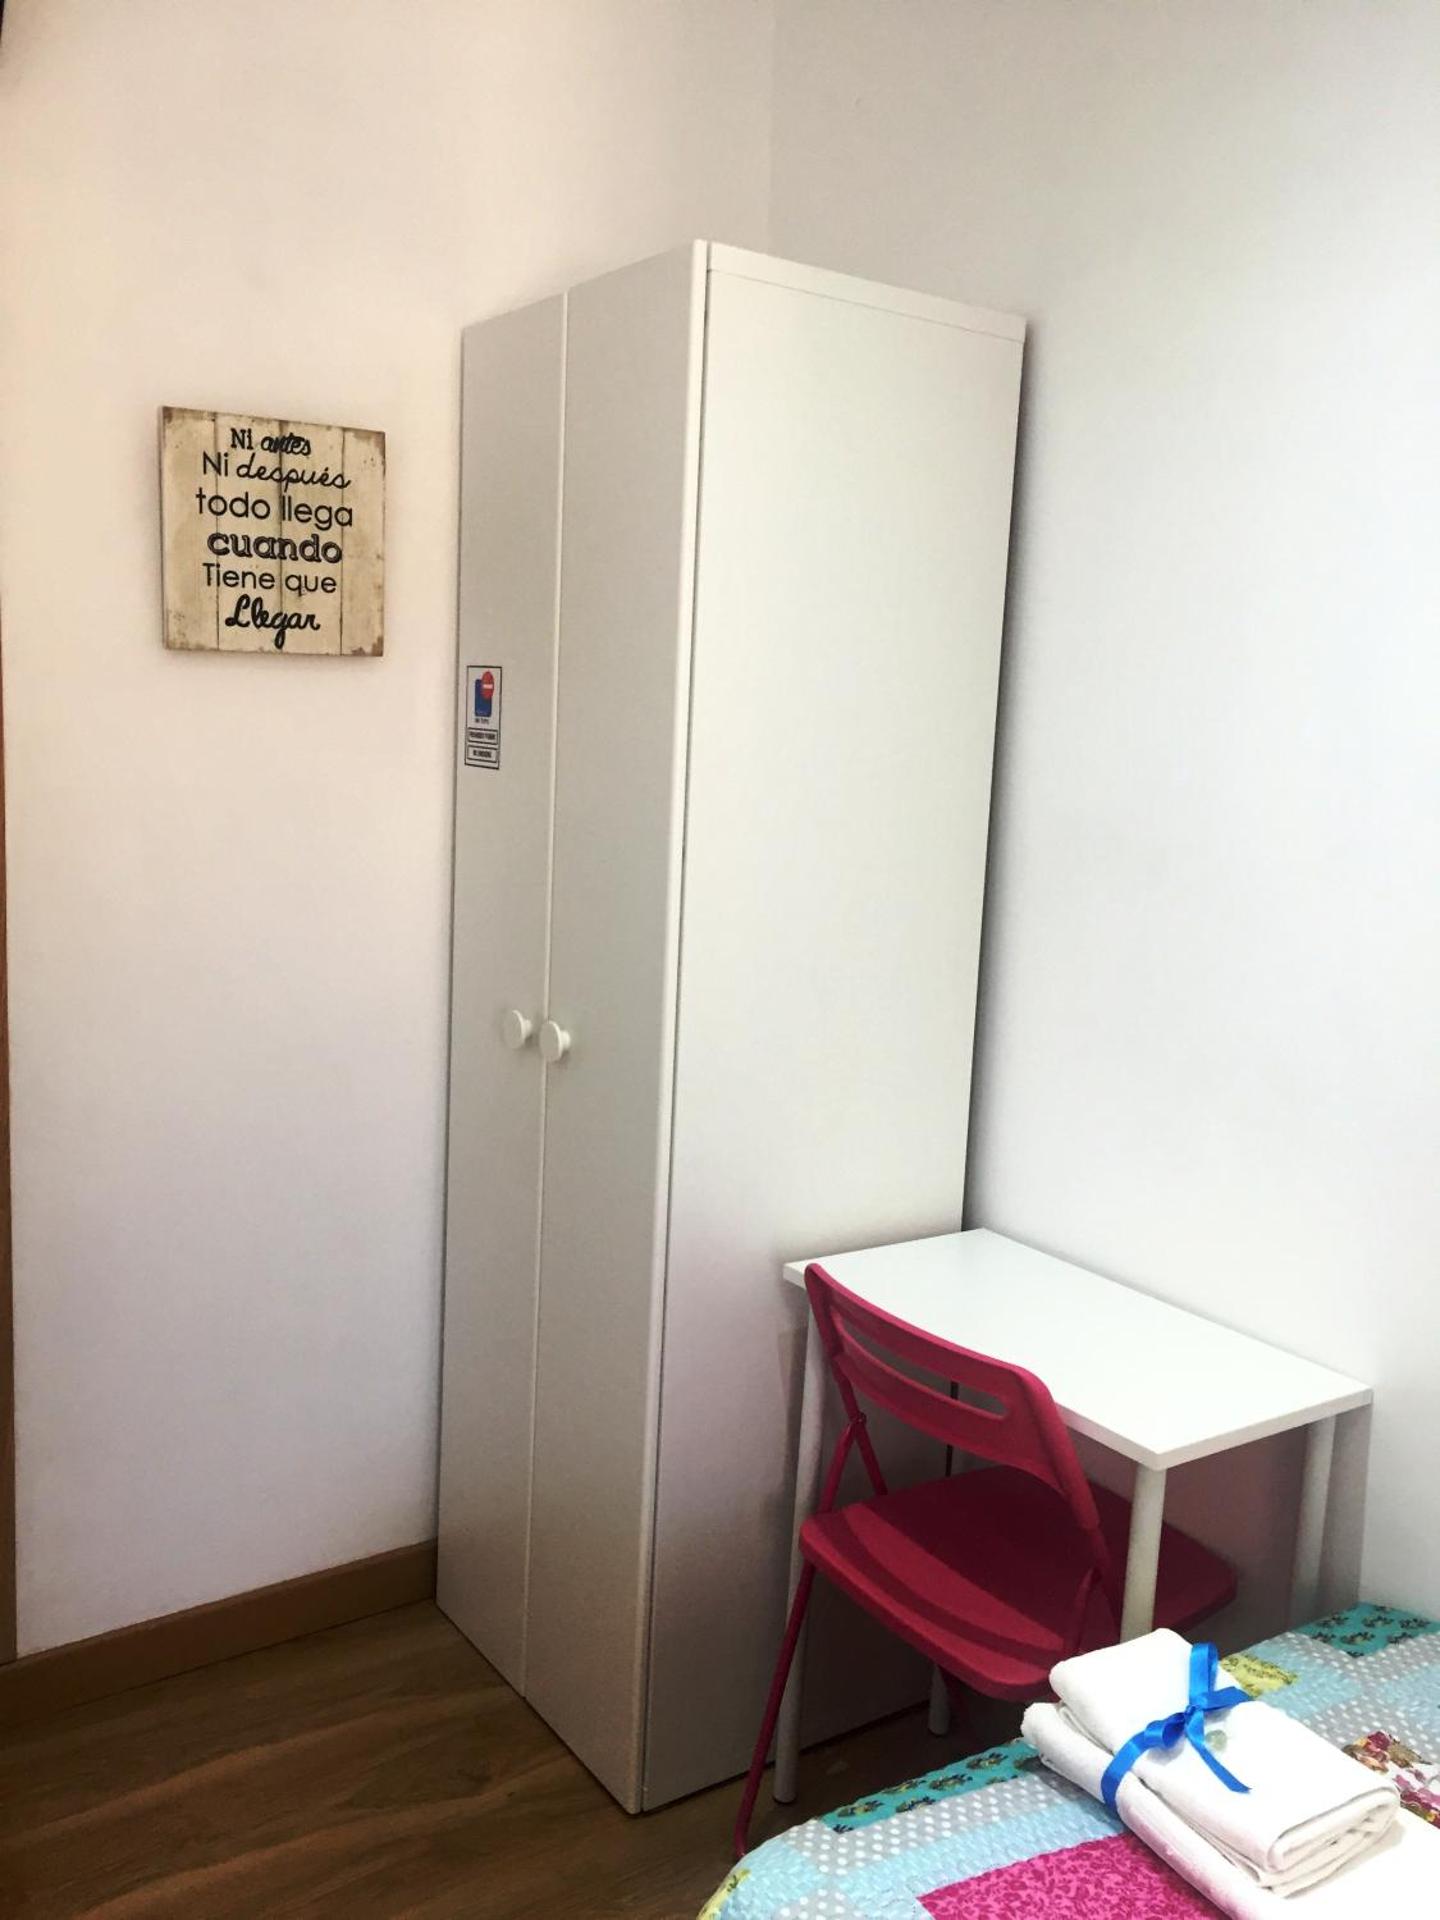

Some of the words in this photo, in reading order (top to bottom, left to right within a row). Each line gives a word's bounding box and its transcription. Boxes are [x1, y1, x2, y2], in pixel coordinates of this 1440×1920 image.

[230, 427, 254, 450] Ni
[261, 432, 312, 457] antes
[203, 452, 229, 477] Ni
[236, 452, 352, 493] después
[195, 487, 271, 520] todo
[281, 495, 353, 531] llega
[207, 532, 343, 564] cuando
[202, 563, 276, 590] Tiene
[284, 573, 337, 597] que
[225, 593, 321, 650] Llegar
